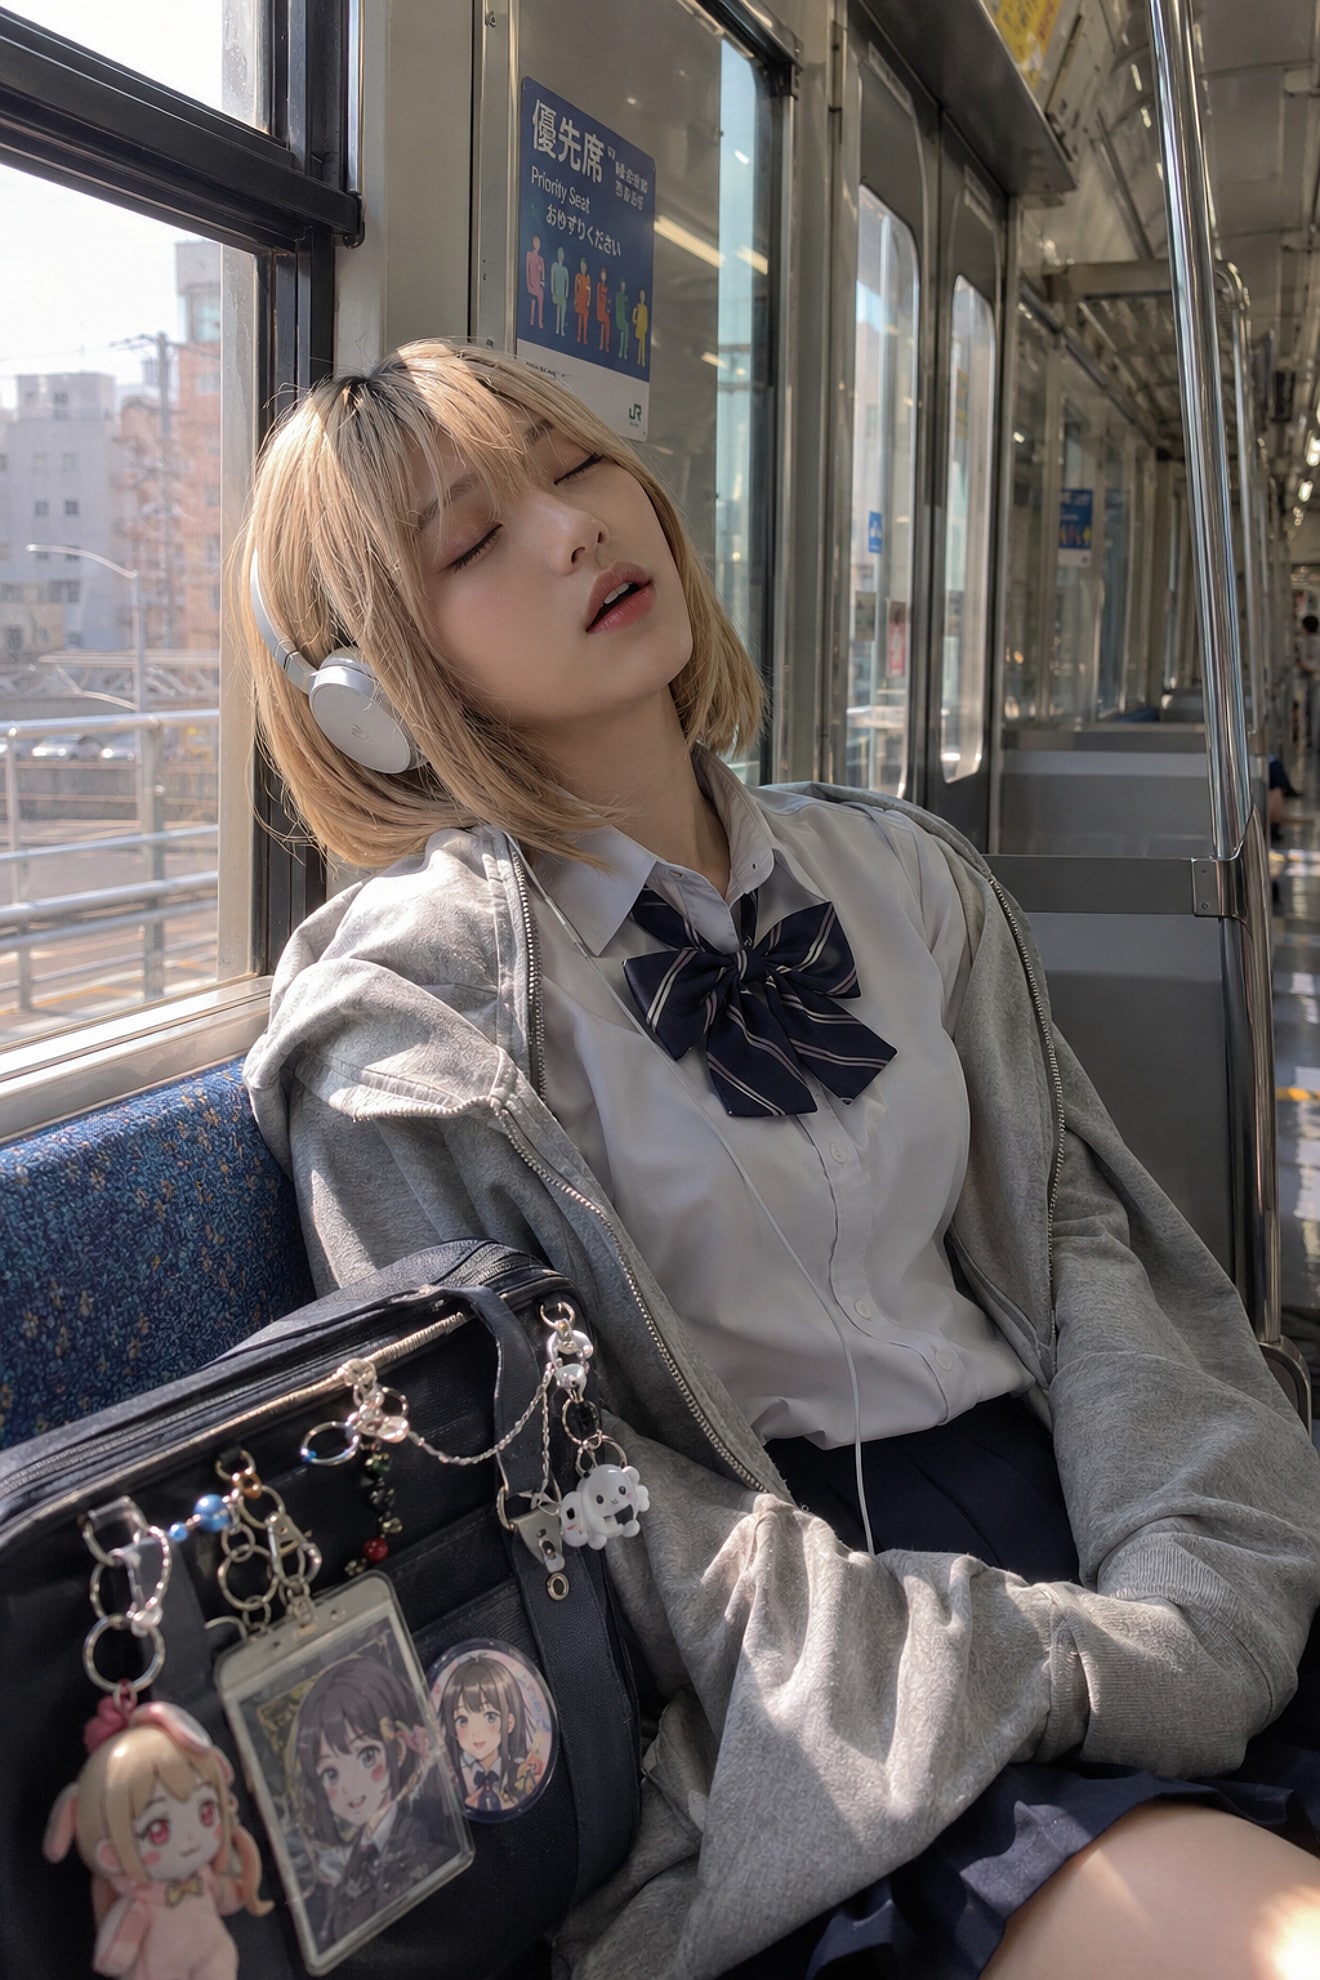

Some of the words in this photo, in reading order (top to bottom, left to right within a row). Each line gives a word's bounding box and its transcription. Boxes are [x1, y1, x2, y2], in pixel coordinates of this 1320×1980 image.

[532, 99, 605, 183] 優先席
[531, 165, 567, 204] Priority
[629, 403, 642, 422] JR
